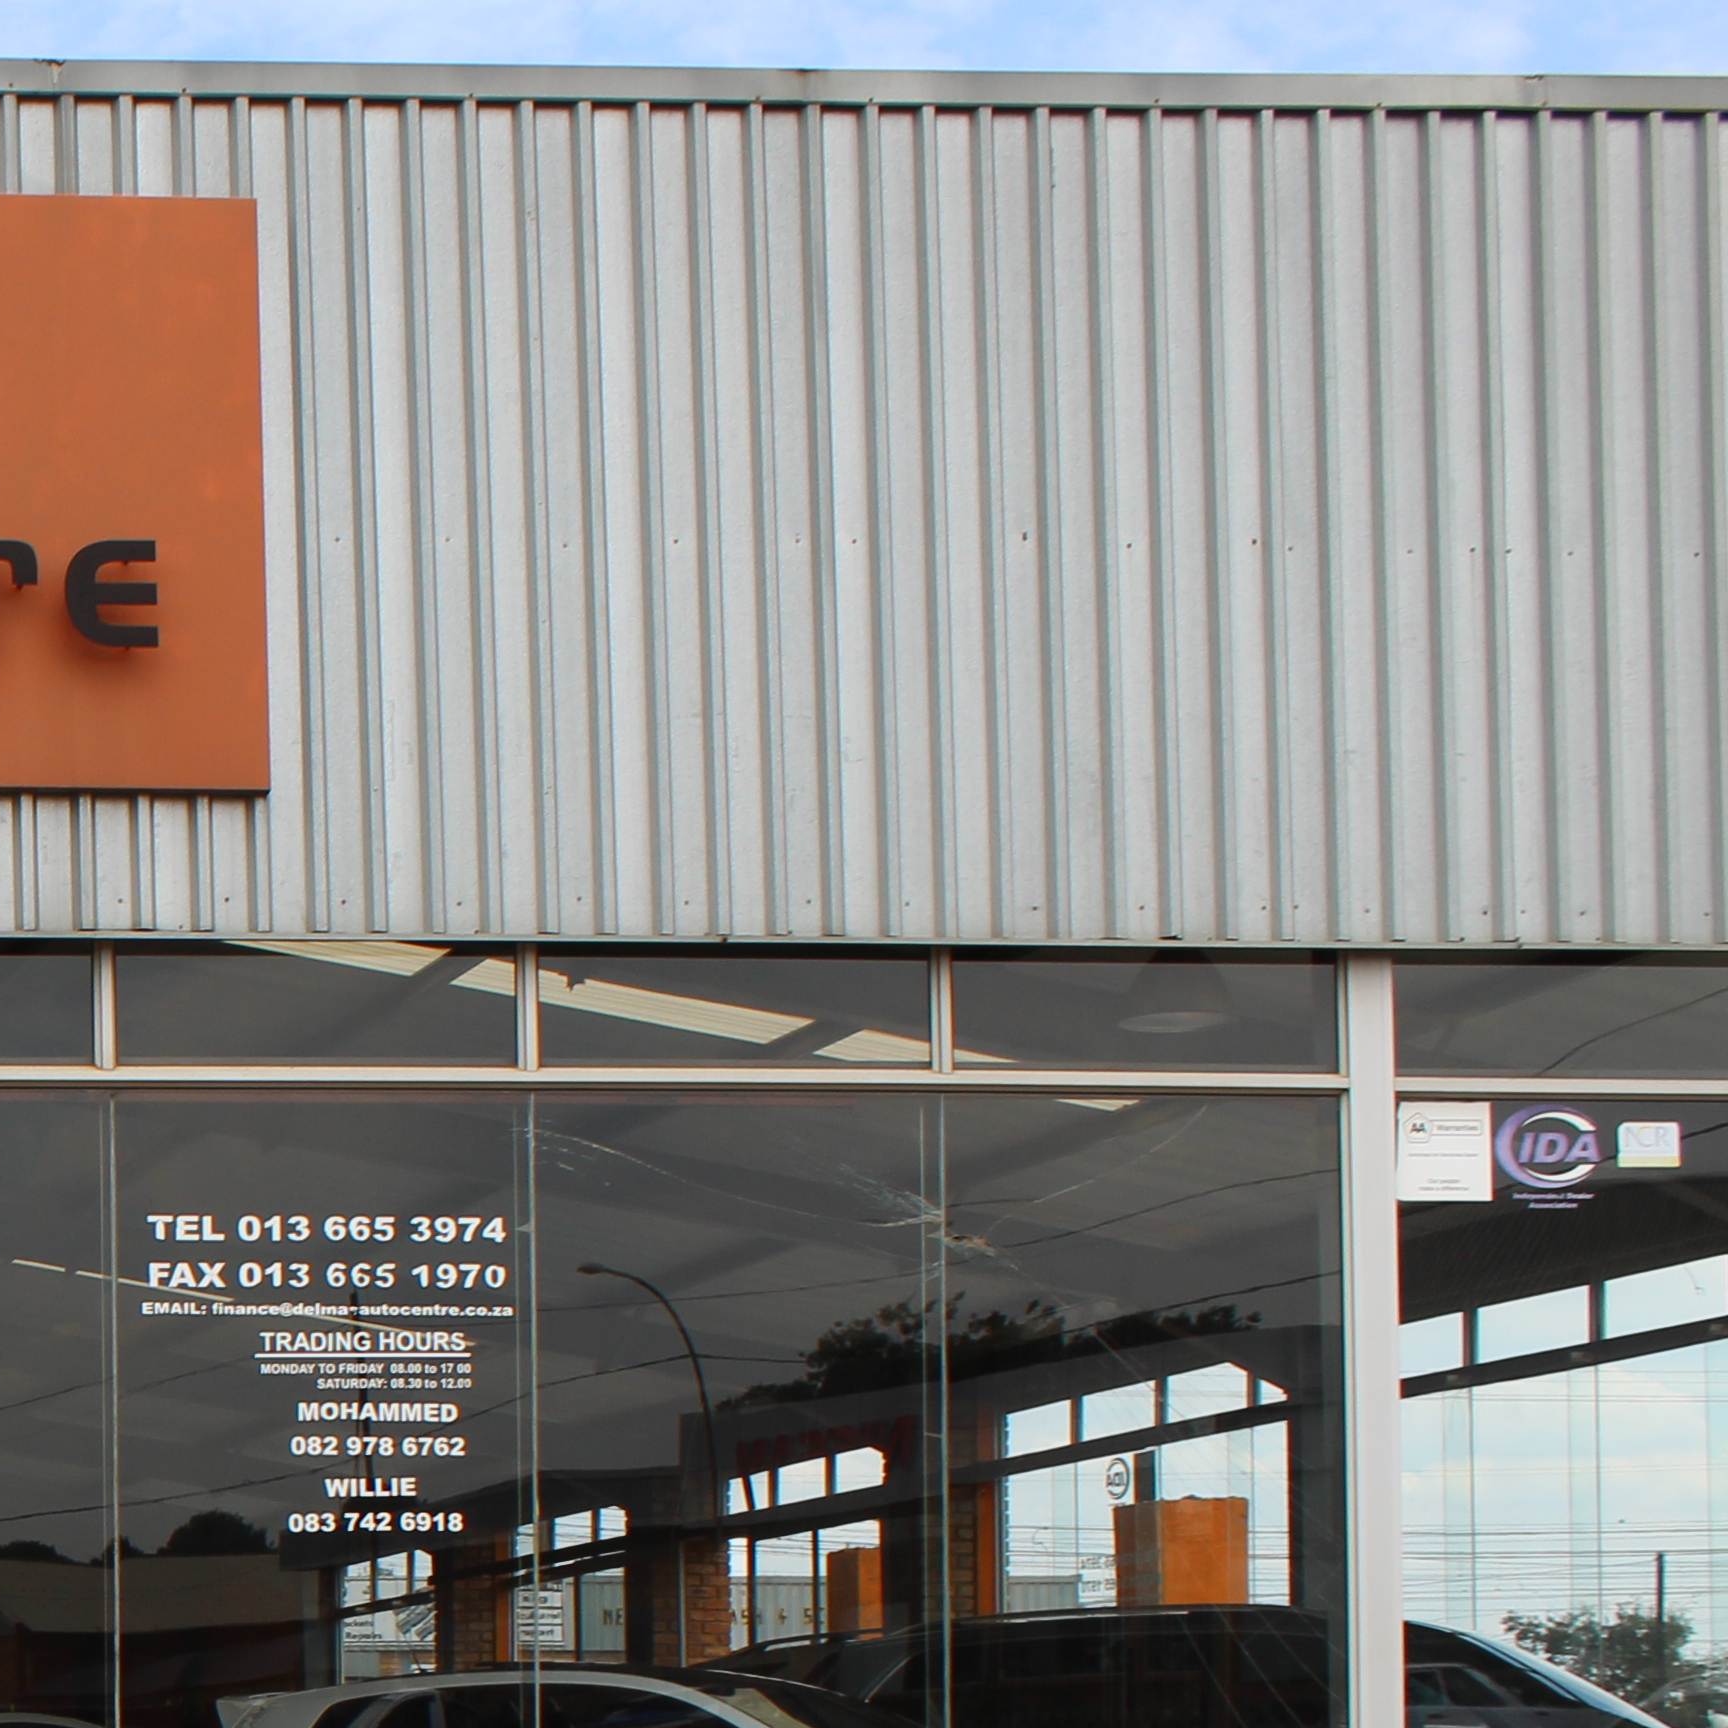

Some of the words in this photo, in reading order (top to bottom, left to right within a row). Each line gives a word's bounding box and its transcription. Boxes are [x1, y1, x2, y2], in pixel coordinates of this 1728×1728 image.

[1518, 1132, 1603, 1163] IDA
[147, 1215, 226, 1242] TEL
[237, 1215, 311, 1242] 013
[323, 1216, 396, 1242] 665
[410, 1216, 507, 1243] 3974
[147, 1262, 226, 1288] FAX
[238, 1262, 310, 1288] 013
[326, 1263, 396, 1288] 665
[411, 1264, 506, 1289] 1970
[141, 1301, 207, 1315] EMAIL:
[259, 1331, 372, 1352] TRADING
[378, 1332, 467, 1352] HOURS
[260, 1363, 315, 1375] MONDAY
[317, 1363, 337, 1375] TO
[338, 1363, 385, 1375] FRIDAY
[424, 1363, 438, 1374] to
[316, 1377, 388, 1390] SATURDAY:
[424, 1378, 438, 1389] to
[440, 1377, 472, 1389] 12.00
[297, 1402, 458, 1423] MOHAMMED
[290, 1435, 339, 1456] 082
[346, 1436, 395, 1456] 978
[402, 1436, 466, 1457] 6762
[324, 1477, 417, 1498] WILLIE
[288, 1512, 336, 1533] 083
[343, 1512, 392, 1532] 742
[400, 1512, 464, 1532] 6918
